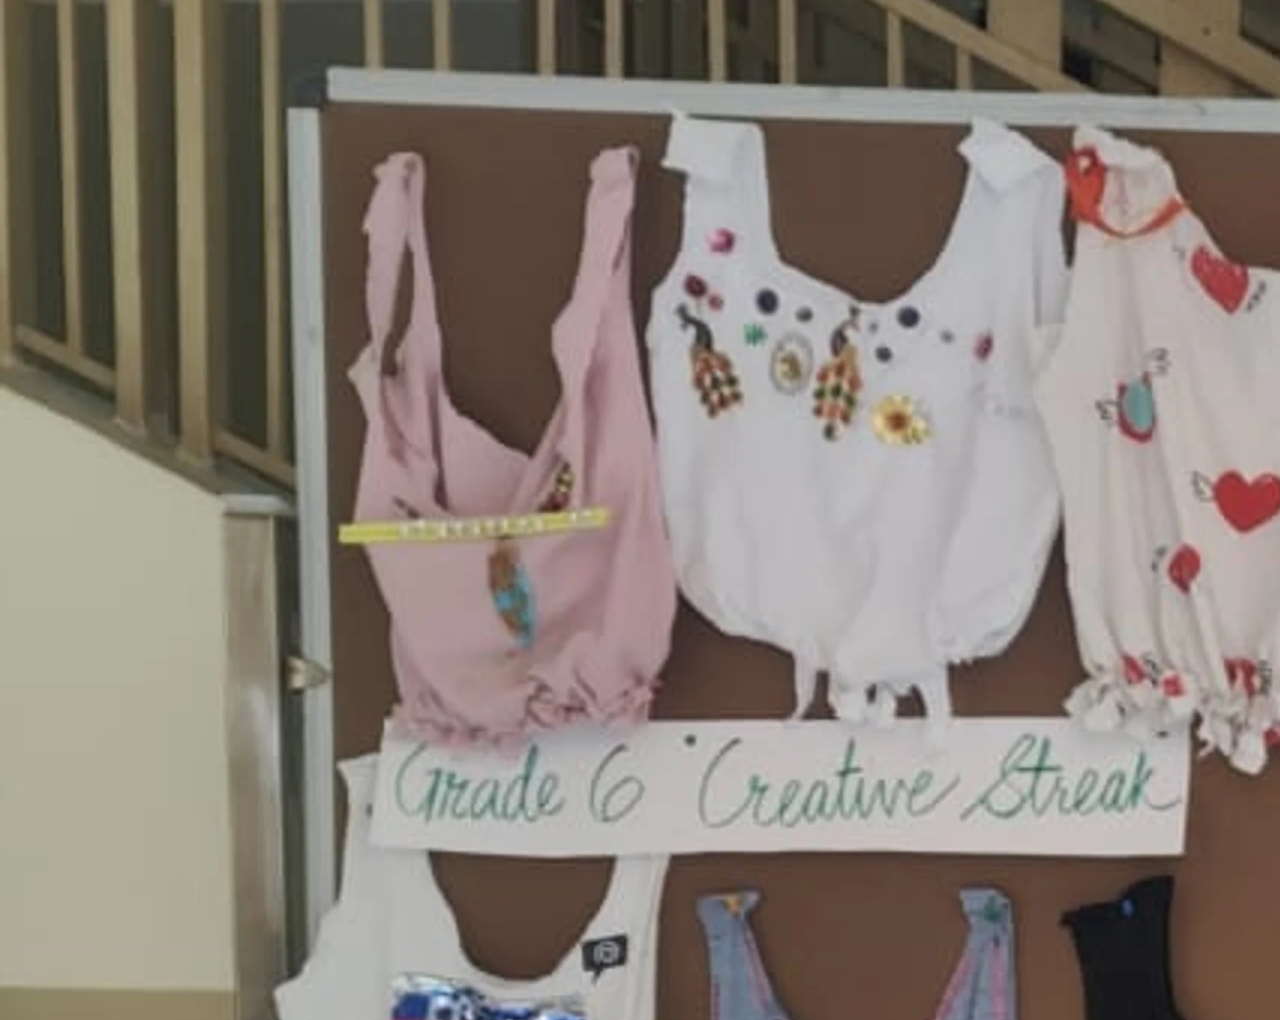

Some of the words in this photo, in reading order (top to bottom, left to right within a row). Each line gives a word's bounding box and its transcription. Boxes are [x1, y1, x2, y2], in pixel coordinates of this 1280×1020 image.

[395, 742, 564, 824] Grade
[589, 743, 645, 823] 6
[699, 738, 961, 829] Creative
[959, 733, 1181, 820] Streak
